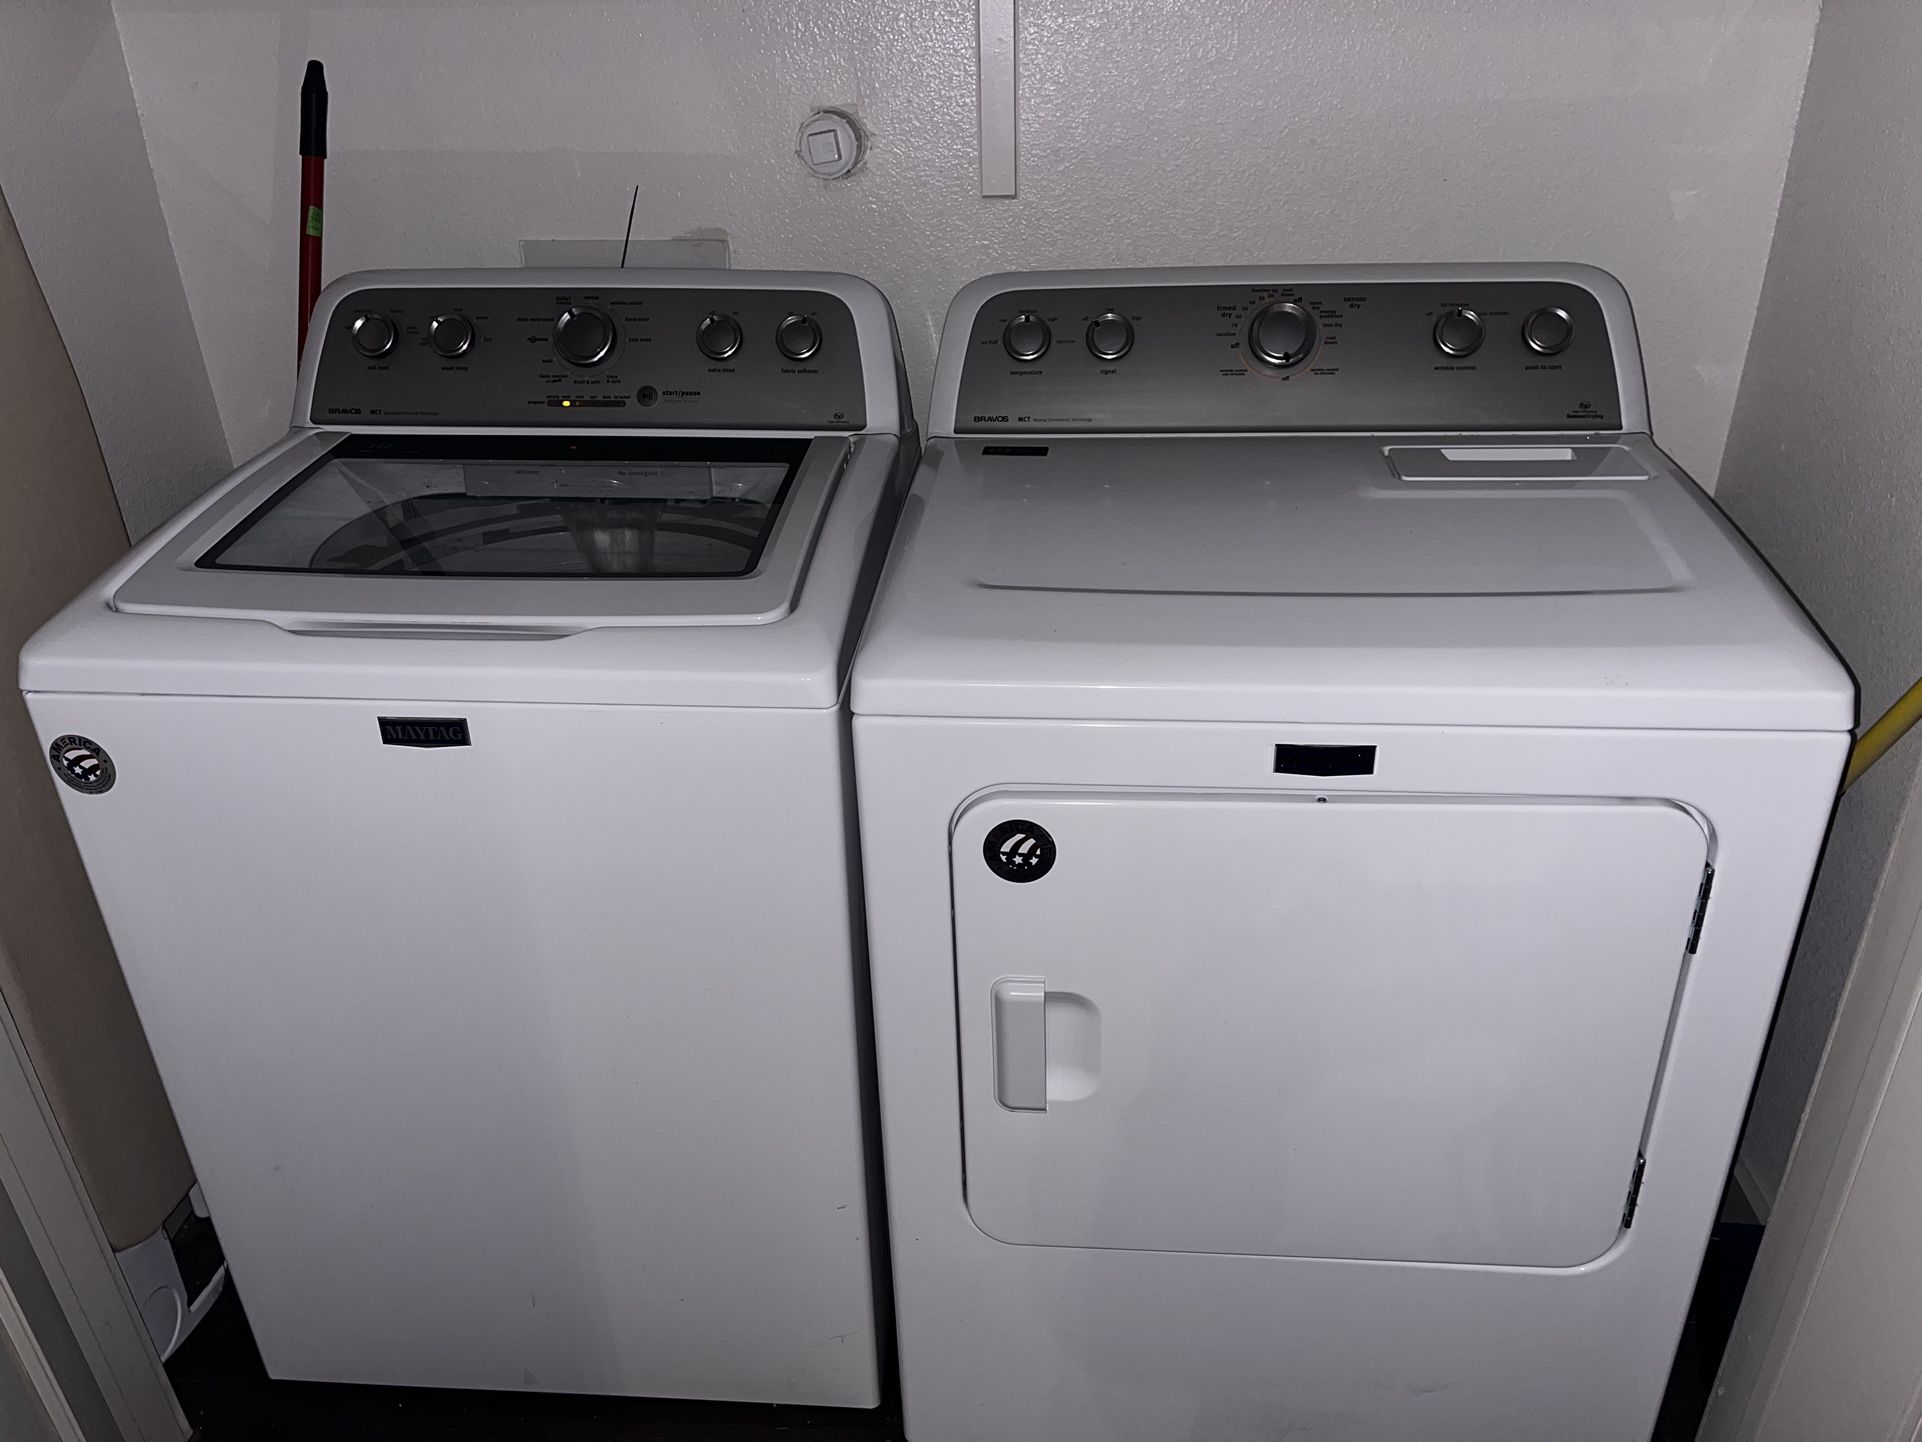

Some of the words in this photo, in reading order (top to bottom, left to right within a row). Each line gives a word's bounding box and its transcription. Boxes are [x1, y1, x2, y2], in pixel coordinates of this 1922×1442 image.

[1349, 302, 1361, 310] dry
[1221, 311, 1232, 319] dry
[1099, 367, 1117, 375] signal
[662, 388, 701, 398] start/pause
[328, 407, 362, 415] BRAVOS
[973, 415, 1009, 423] BRAVOS
[384, 725, 463, 740] MAYTAG
[51, 736, 100, 763] AMERICA
